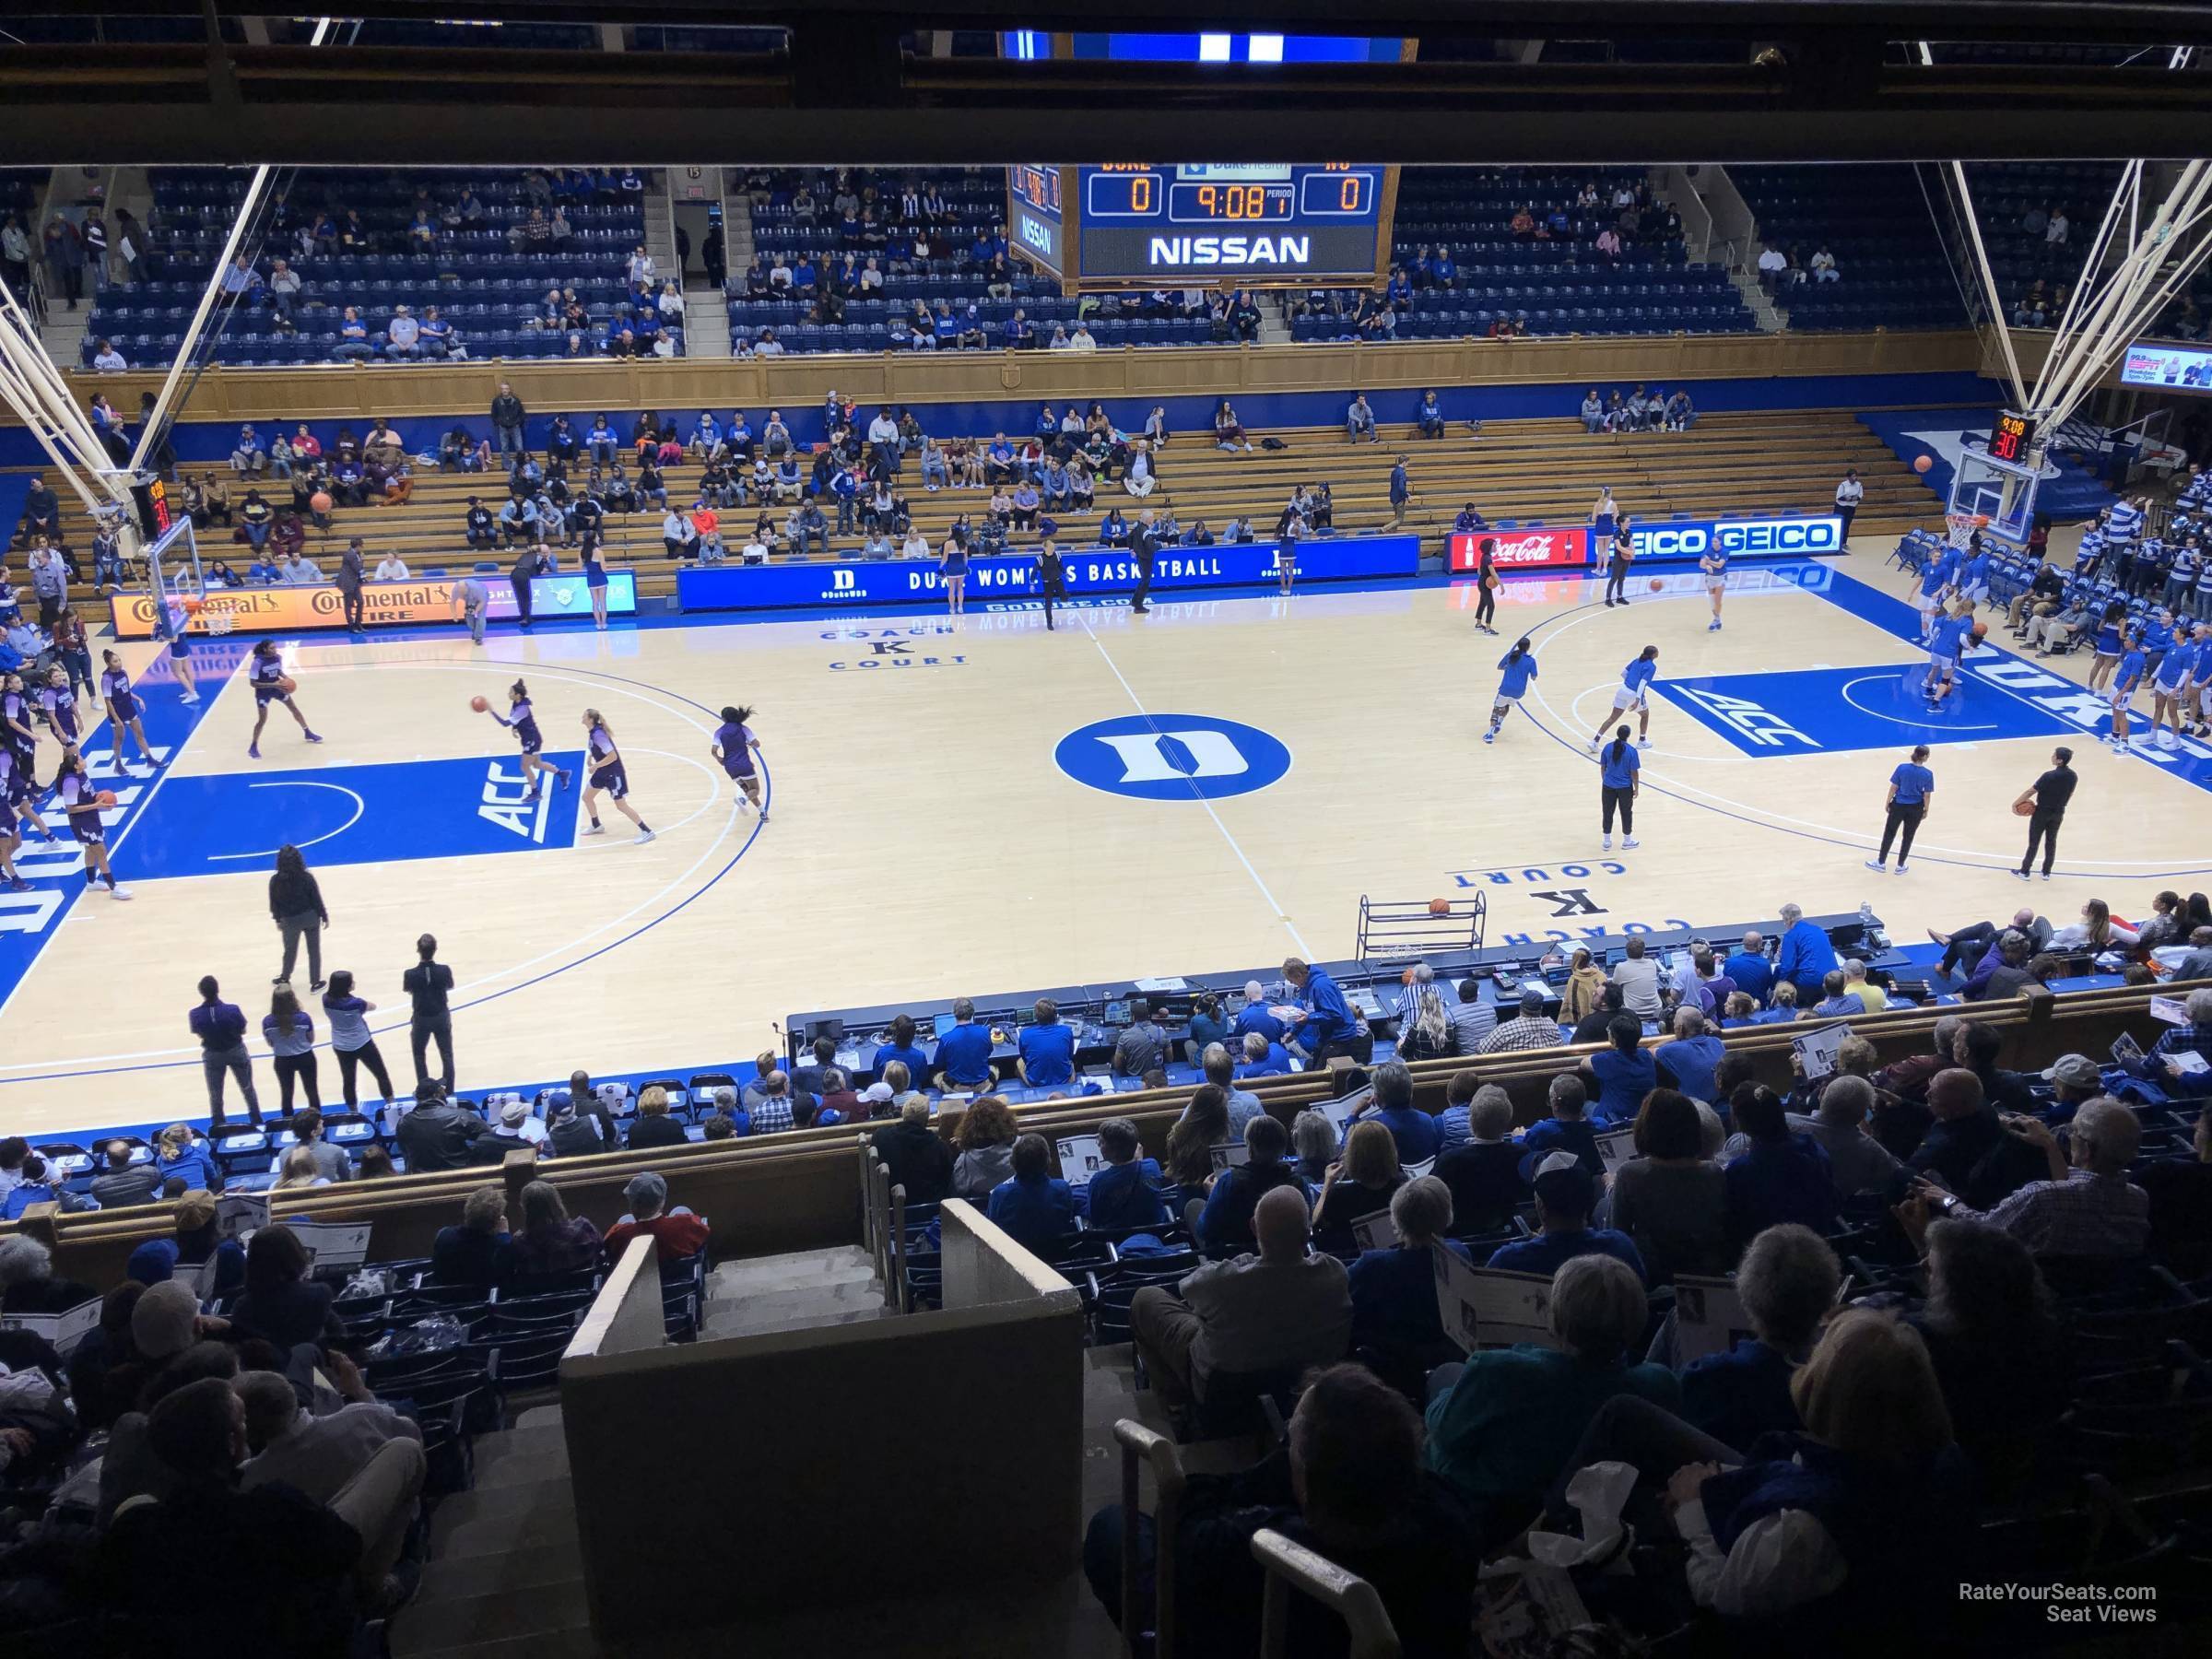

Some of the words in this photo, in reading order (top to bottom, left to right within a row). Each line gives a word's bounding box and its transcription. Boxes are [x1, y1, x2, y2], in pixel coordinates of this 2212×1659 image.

[688, 167, 700, 177] 15
[1132, 178, 1150, 211] 0
[1199, 186, 1265, 218] 9:08
[1266, 189, 1291, 197] PERIOD
[1341, 178, 1359, 209] 0
[1022, 214, 1051, 254] NISSAN
[1150, 236, 1309, 265] NISSAN
[2003, 418, 2025, 435] 9:08
[1994, 431, 2017, 458] 30
[1719, 524, 1833, 553] GEICO
[1088, 558, 1221, 582] BASKTBALL
[820, 627, 955, 640] COACH
[867, 640, 915, 655] K
[829, 655, 967, 669] COURT
[1688, 688, 1824, 748] ACC
[1093, 730, 1250, 783] D
[1454, 861, 1627, 888] COURT
[1528, 888, 1611, 918] K
